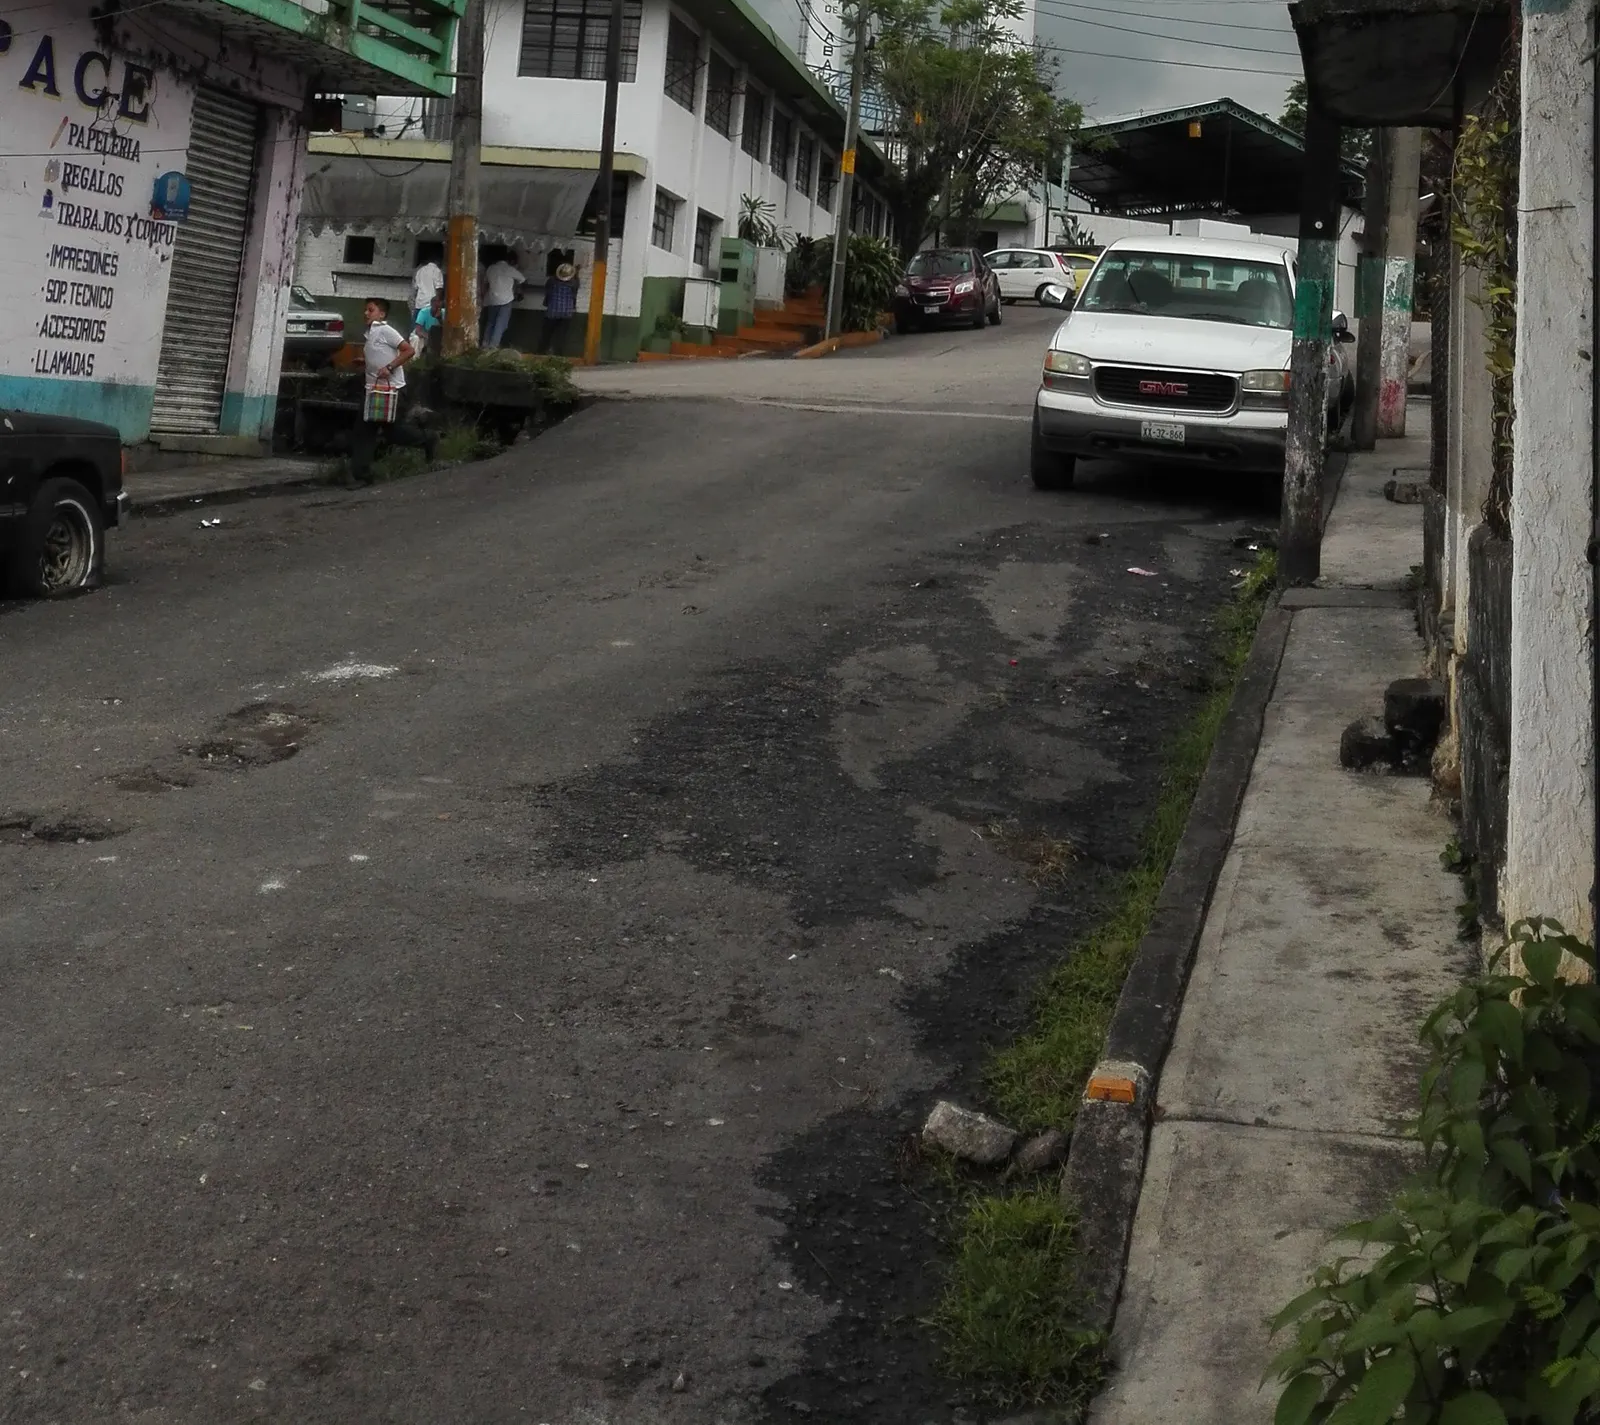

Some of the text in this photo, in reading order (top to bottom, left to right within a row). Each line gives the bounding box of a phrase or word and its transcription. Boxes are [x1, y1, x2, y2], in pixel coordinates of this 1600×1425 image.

[67, 123, 141, 162] PAPELERIA
[62, 162, 125, 197] REGALOS
[57, 201, 123, 236] TRABAJOS
[50, 244, 119, 277] IMPRESIONES
[45, 279, 114, 309] SOP. TECNICO
[40, 314, 107, 343] ACCESORIOS
[35, 349, 95, 376] LLAMADAS
[1140, 380, 1188, 395] GMC
